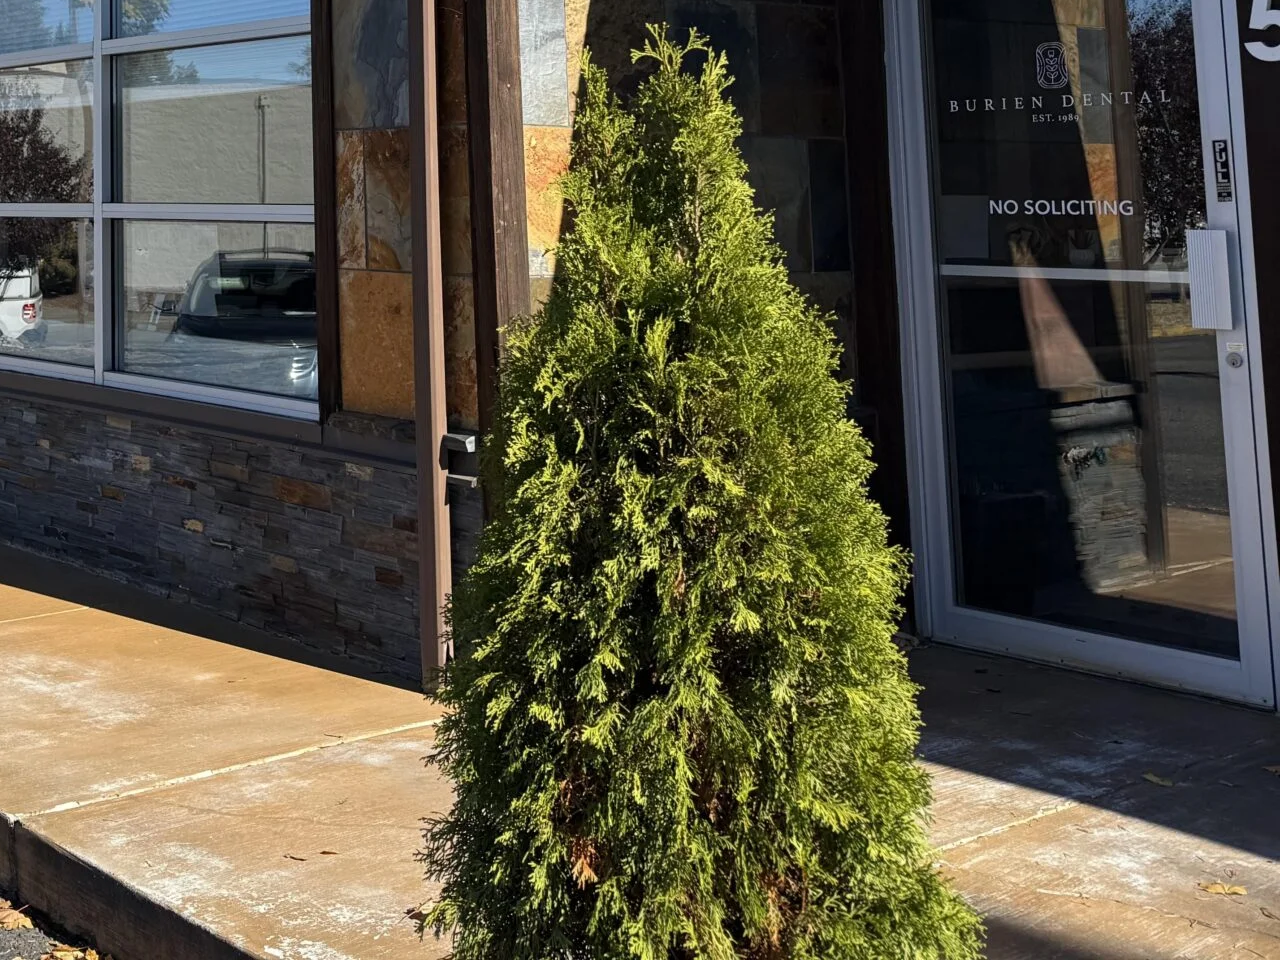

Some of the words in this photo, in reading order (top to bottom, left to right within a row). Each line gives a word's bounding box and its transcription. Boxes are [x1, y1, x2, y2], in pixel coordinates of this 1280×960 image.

[949, 96, 1044, 113] BURIEN
[1062, 89, 1171, 108] DENTAL
[1032, 113, 1055, 123] EST.
[1058, 113, 1080, 123] 1989
[1214, 141, 1229, 183] PULL
[989, 199, 1019, 215] NO
[1024, 199, 1134, 216] SOLICITING
